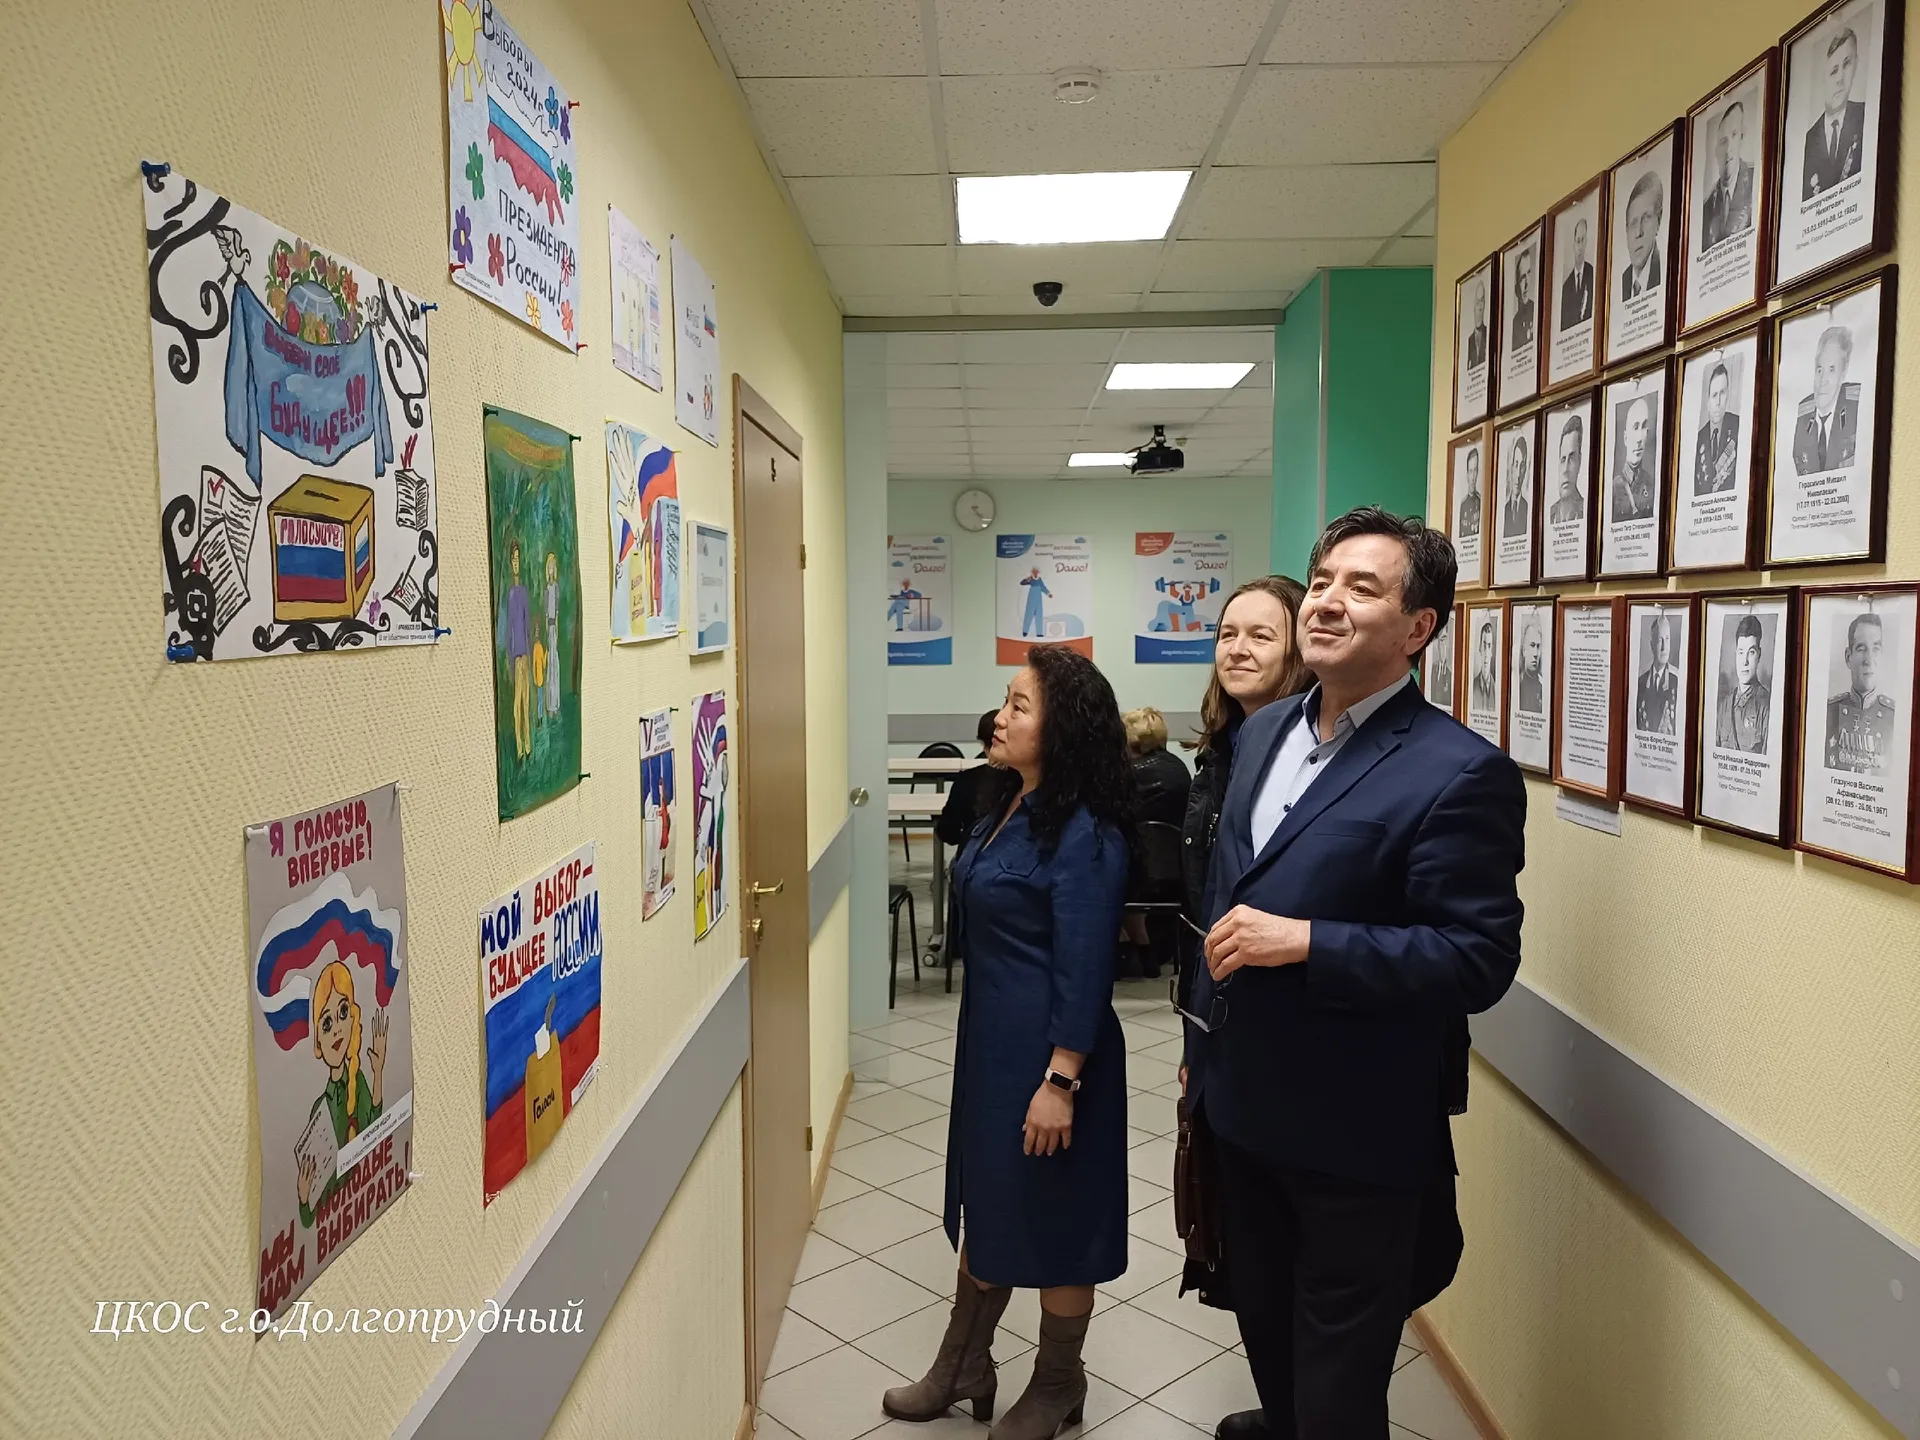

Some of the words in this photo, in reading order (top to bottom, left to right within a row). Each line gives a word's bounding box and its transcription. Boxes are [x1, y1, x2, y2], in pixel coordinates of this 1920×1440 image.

[499, 189, 576, 277] ПРЕЗИДЕНТА
[506, 236, 562, 317] России!
[913, 562, 947, 574] Долго!
[1055, 562, 1088, 573] Долго!
[1194, 560, 1228, 571] Долго!
[1830, 776, 1857, 788] Глазунов
[1858, 780, 1884, 793] Василий
[270, 821, 284, 858] Я
[294, 800, 367, 852] ГОЛОСУЮ
[287, 820, 372, 888] ВПЕРВЫЕ!
[481, 890, 522, 960] МОЙ
[489, 932, 545, 1000] БУДУЩЕЕ
[552, 890, 601, 982] РОССИИ
[261, 1218, 295, 1284] МЫ
[316, 1134, 394, 1229] МОЛОДЫЕ
[317, 1141, 410, 1265] ВЫБИРАТЬ!
